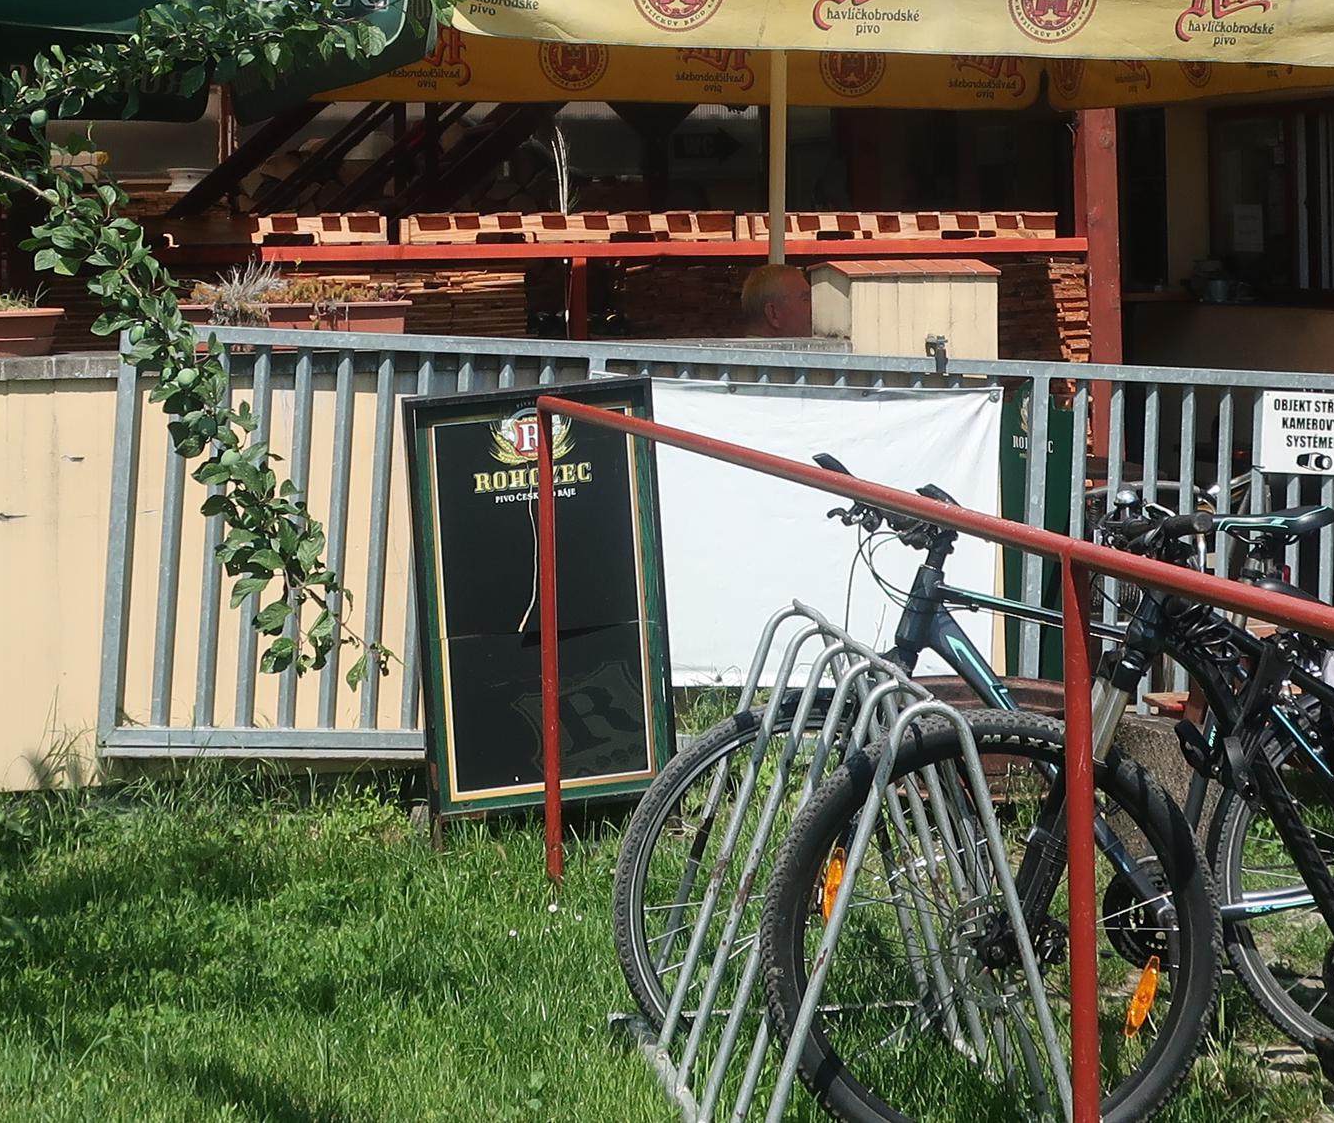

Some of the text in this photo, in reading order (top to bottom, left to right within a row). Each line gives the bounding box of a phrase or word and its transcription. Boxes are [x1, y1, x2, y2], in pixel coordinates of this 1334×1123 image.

[469, 3, 496, 16] pivo
[827, 7, 920, 22] havlíčkobrodské
[855, 22, 881, 36] pivo
[1188, 20, 1275, 34] havlíčkobrodské
[1213, 34, 1237, 47] pivo
[1273, 398, 1312, 412] OBJEKT
[474, 462, 593, 493] ROHOEC
[495, 493, 516, 503] PIVO
[557, 487, 577, 498] RÁJE
[979, 734, 1064, 753] MAXX
